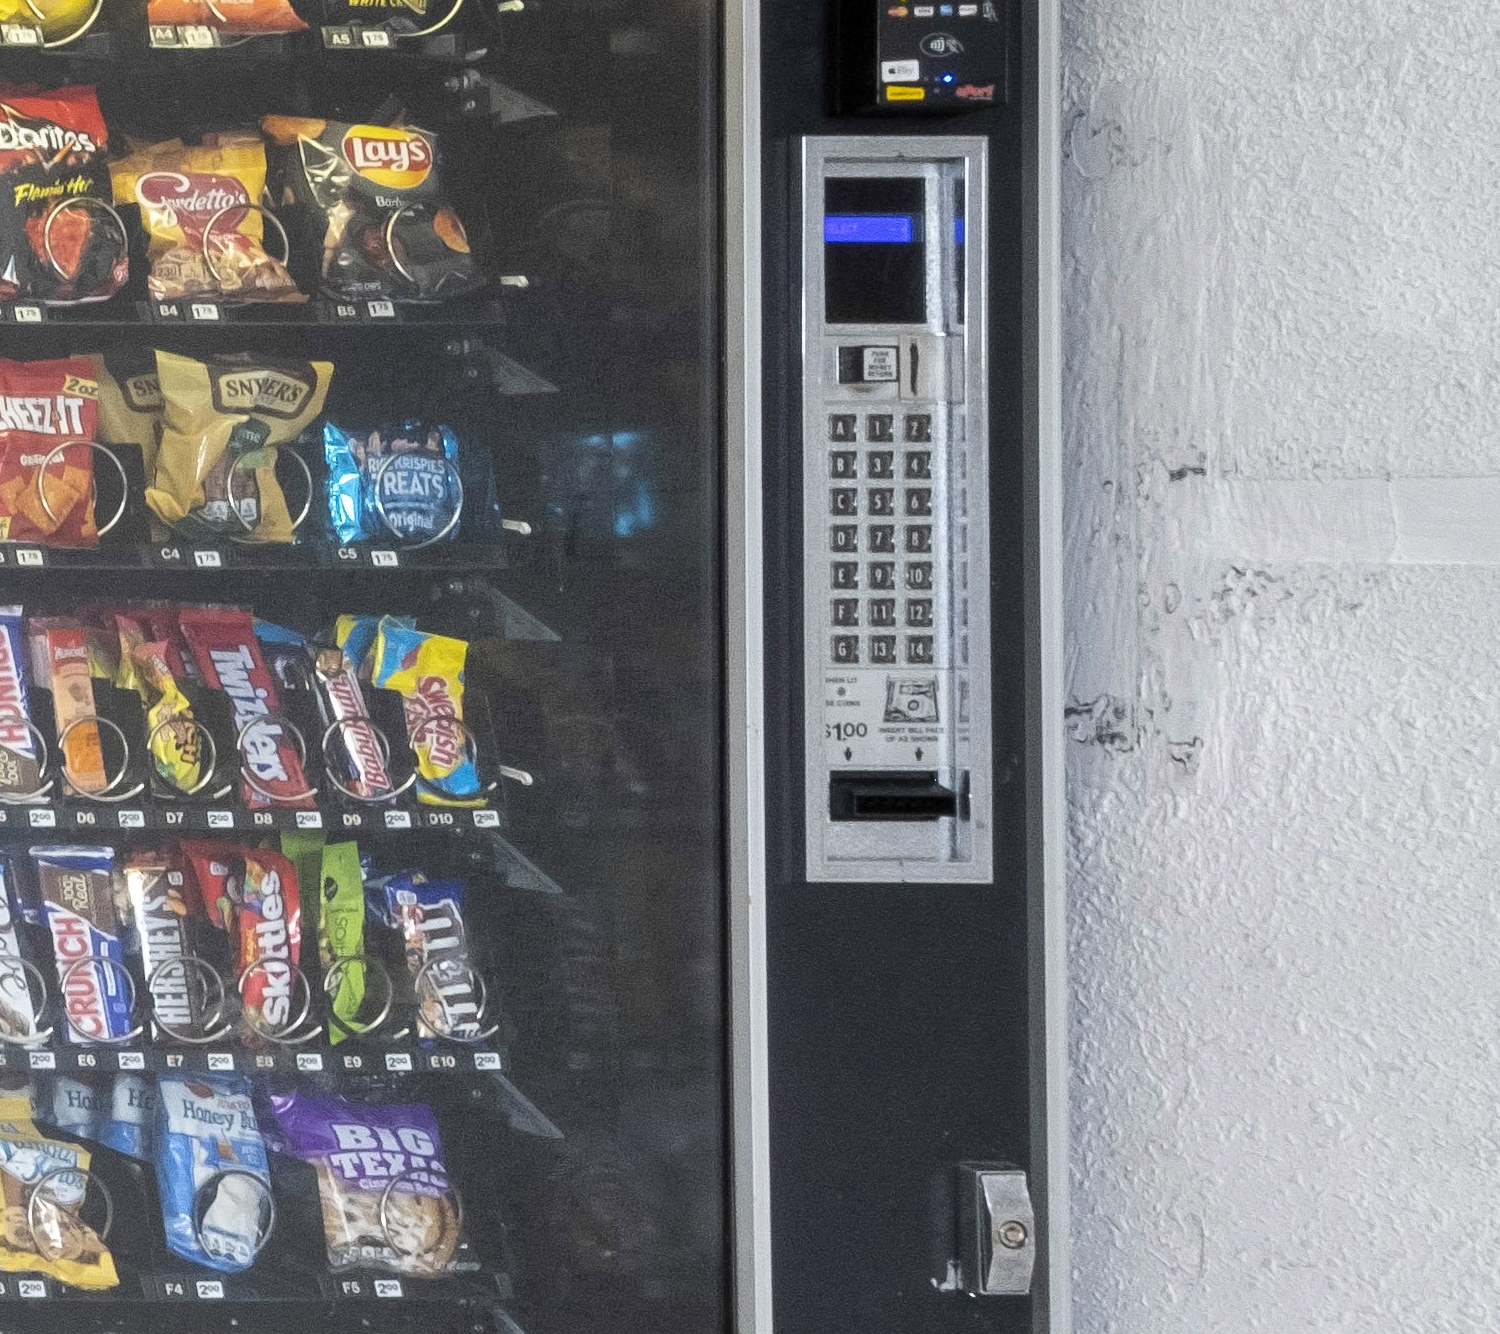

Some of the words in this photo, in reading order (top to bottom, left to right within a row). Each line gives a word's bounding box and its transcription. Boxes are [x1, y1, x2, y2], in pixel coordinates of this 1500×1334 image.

[155, 28, 173, 40] A4
[332, 34, 350, 45] A5
[835, 422, 843, 436] A
[874, 421, 881, 436] 1
[910, 421, 918, 436] 2
[837, 458, 845, 473] B
[873, 458, 881, 473] 3
[910, 458, 919, 473] 4
[837, 495, 845, 510] C
[874, 495, 882, 510] 5
[911, 495, 918, 510] 6
[876, 532, 882, 546] 7
[911, 532, 918, 546] 8
[161, 548, 180, 560] C4
[875, 570, 882, 584] 9
[908, 570, 923, 584] 10
[837, 606, 845, 620] F
[873, 606, 887, 620] 11
[909, 606, 923, 620] 12
[837, 643, 846, 657] G
[873, 643, 887, 657] 13
[909, 643, 924, 657] 14
[52, 915, 107, 1038] CRUNCH
[182, 1099, 235, 1132] Honey
[332, 1124, 435, 1157] BIG
[166, 1283, 184, 1296] F4
